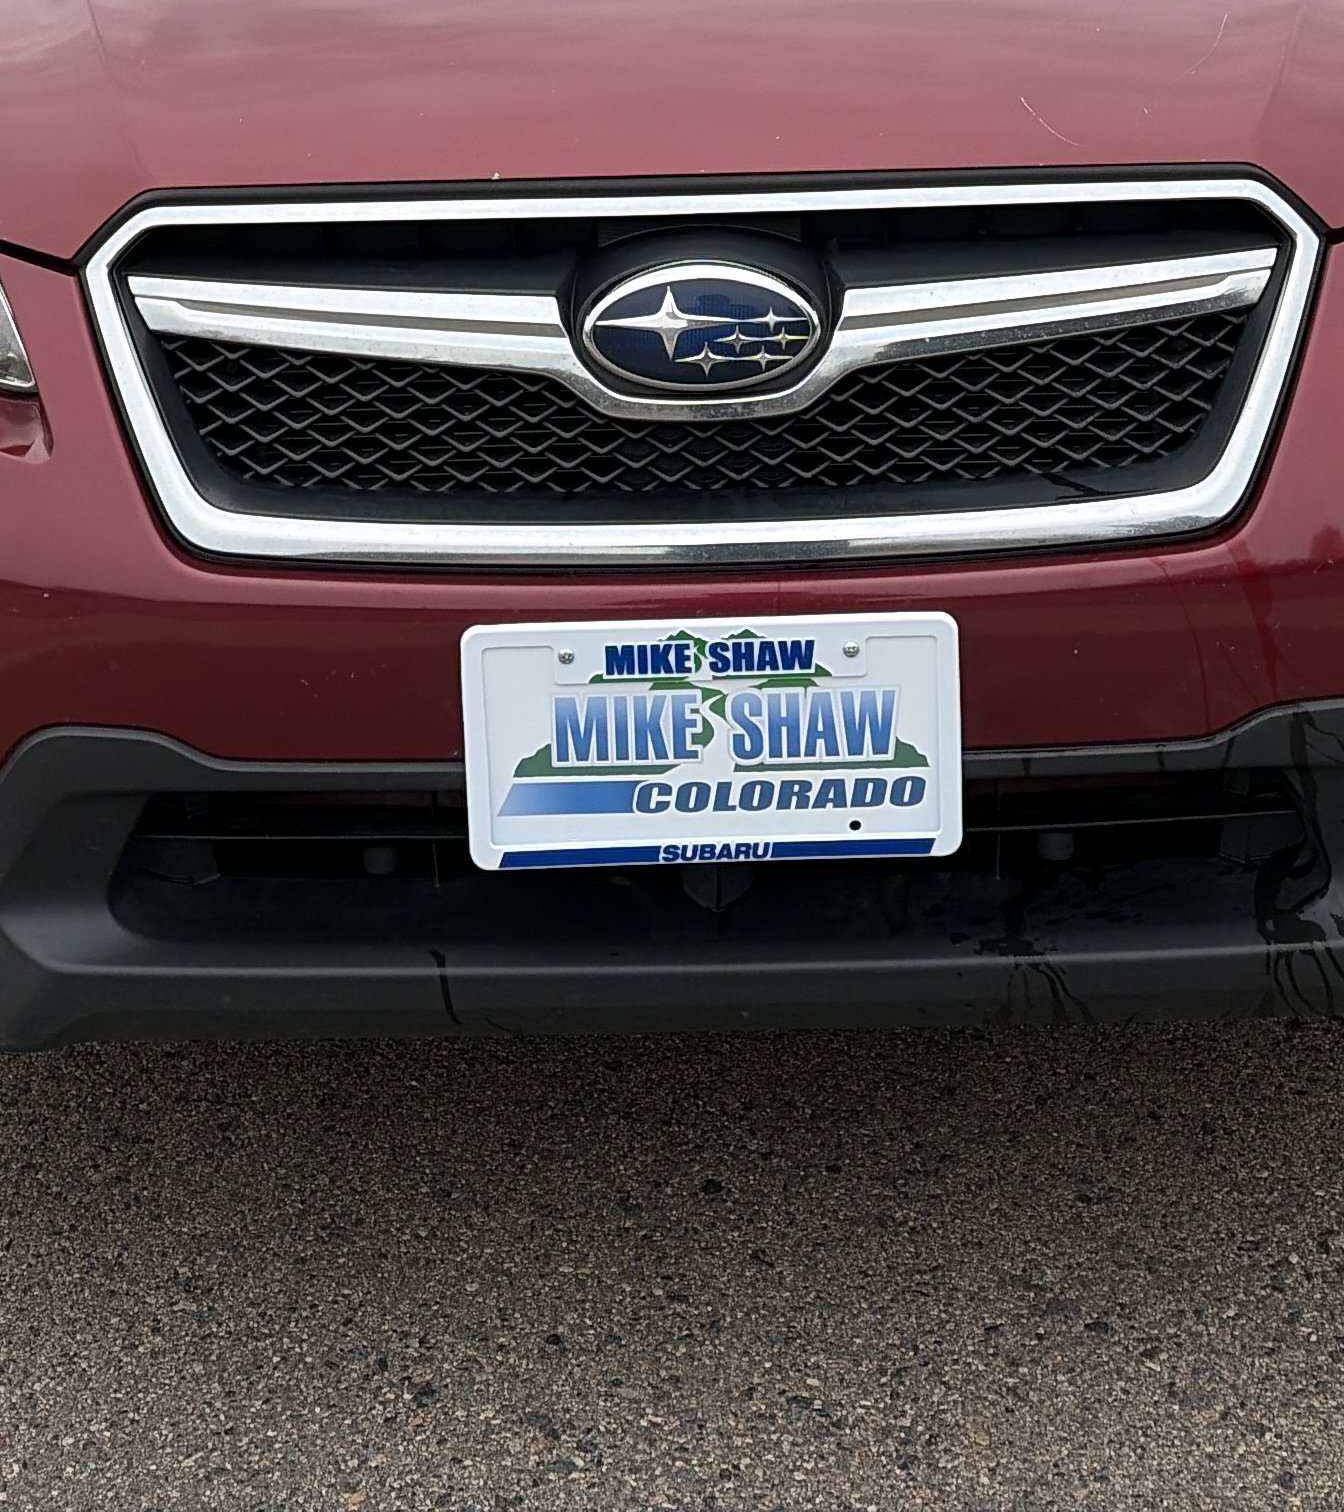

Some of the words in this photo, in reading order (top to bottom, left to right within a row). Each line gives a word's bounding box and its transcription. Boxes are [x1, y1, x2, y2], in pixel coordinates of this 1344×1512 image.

[604, 645, 693, 675] MIKE
[709, 639, 816, 672] SHAW
[554, 692, 700, 762] MIKE
[729, 689, 896, 762] SHAW
[634, 775, 927, 814] COLORADO
[660, 841, 771, 862] SUBARU
